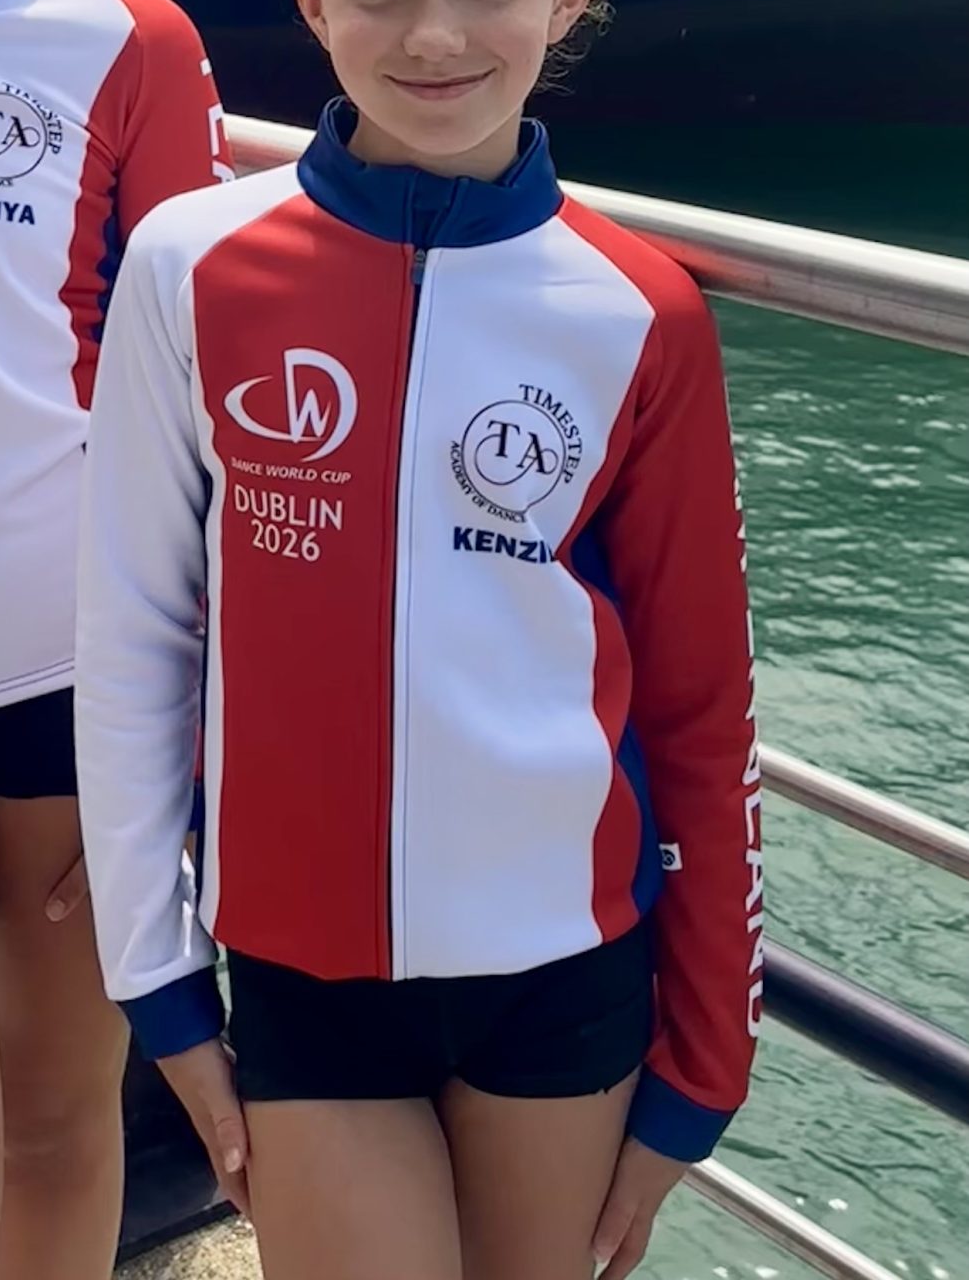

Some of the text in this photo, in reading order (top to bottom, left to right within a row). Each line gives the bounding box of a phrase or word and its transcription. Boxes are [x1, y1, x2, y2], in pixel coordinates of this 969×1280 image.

[518, 383, 583, 484] TIMESTEP
[265, 464, 318, 482] WORLD
[320, 469, 352, 485] CUP
[449, 440, 474, 496] ACADEMY
[471, 494, 488, 509] OF
[234, 483, 343, 532] DUBLIN
[250, 519, 321, 563] 2026
